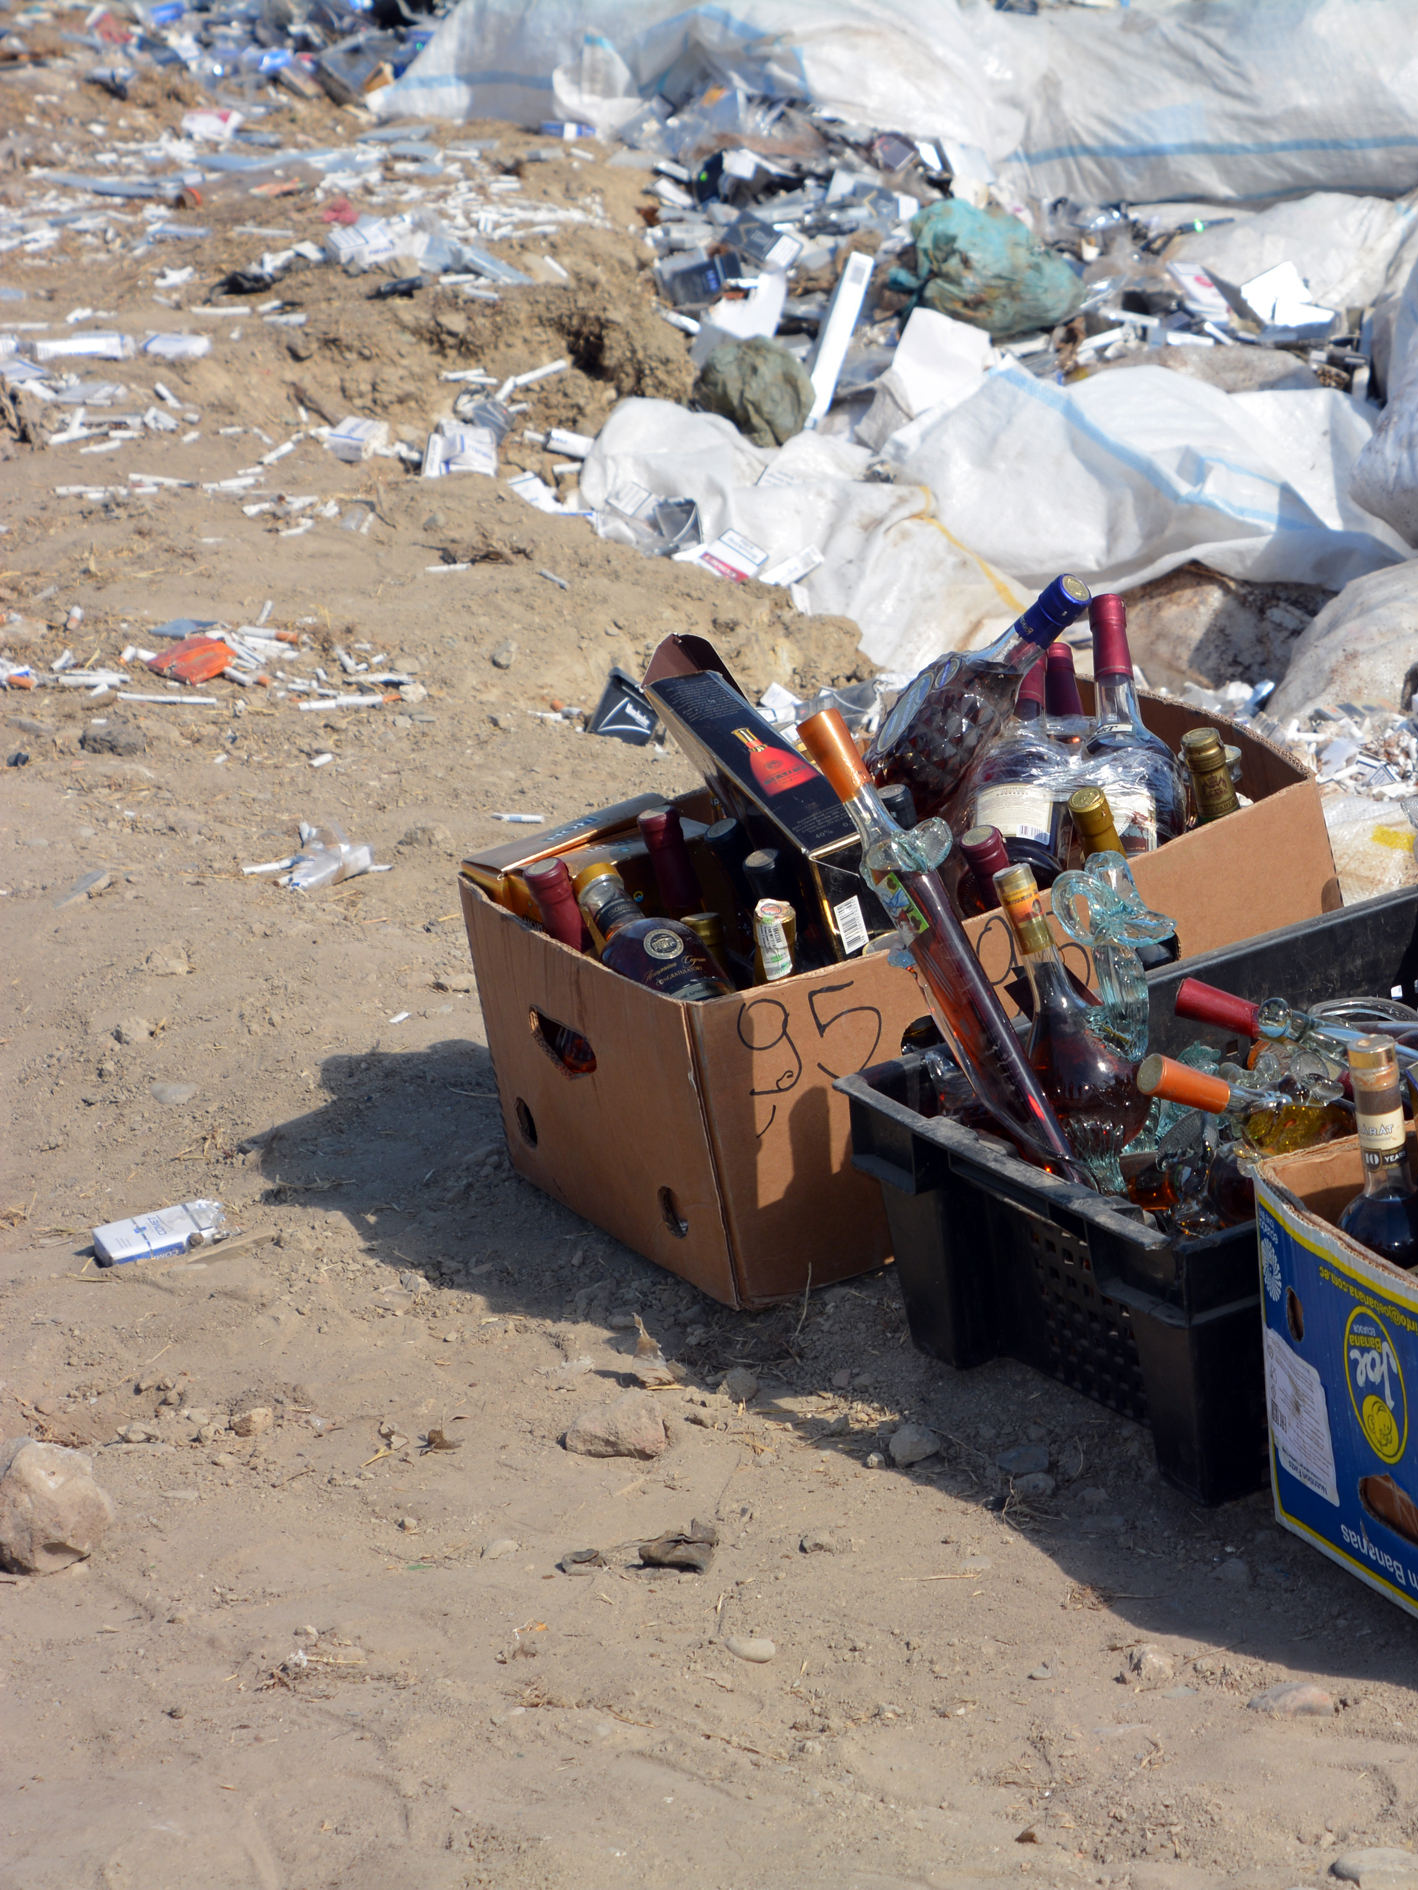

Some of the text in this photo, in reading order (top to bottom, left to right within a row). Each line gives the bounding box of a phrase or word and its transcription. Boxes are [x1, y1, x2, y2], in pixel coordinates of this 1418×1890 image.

[1357, 1123, 1394, 1136] ARAT
[1365, 1150, 1406, 1165] 10 YEARS
[147, 1216, 167, 1236] COMET
[1319, 1266, 1418, 1335] info@joebanana.com.ec
[1349, 1334, 1383, 1353] Banana
[1349, 1341, 1398, 1411] Joe
[1340, 1523, 1406, 1586] Bananas
